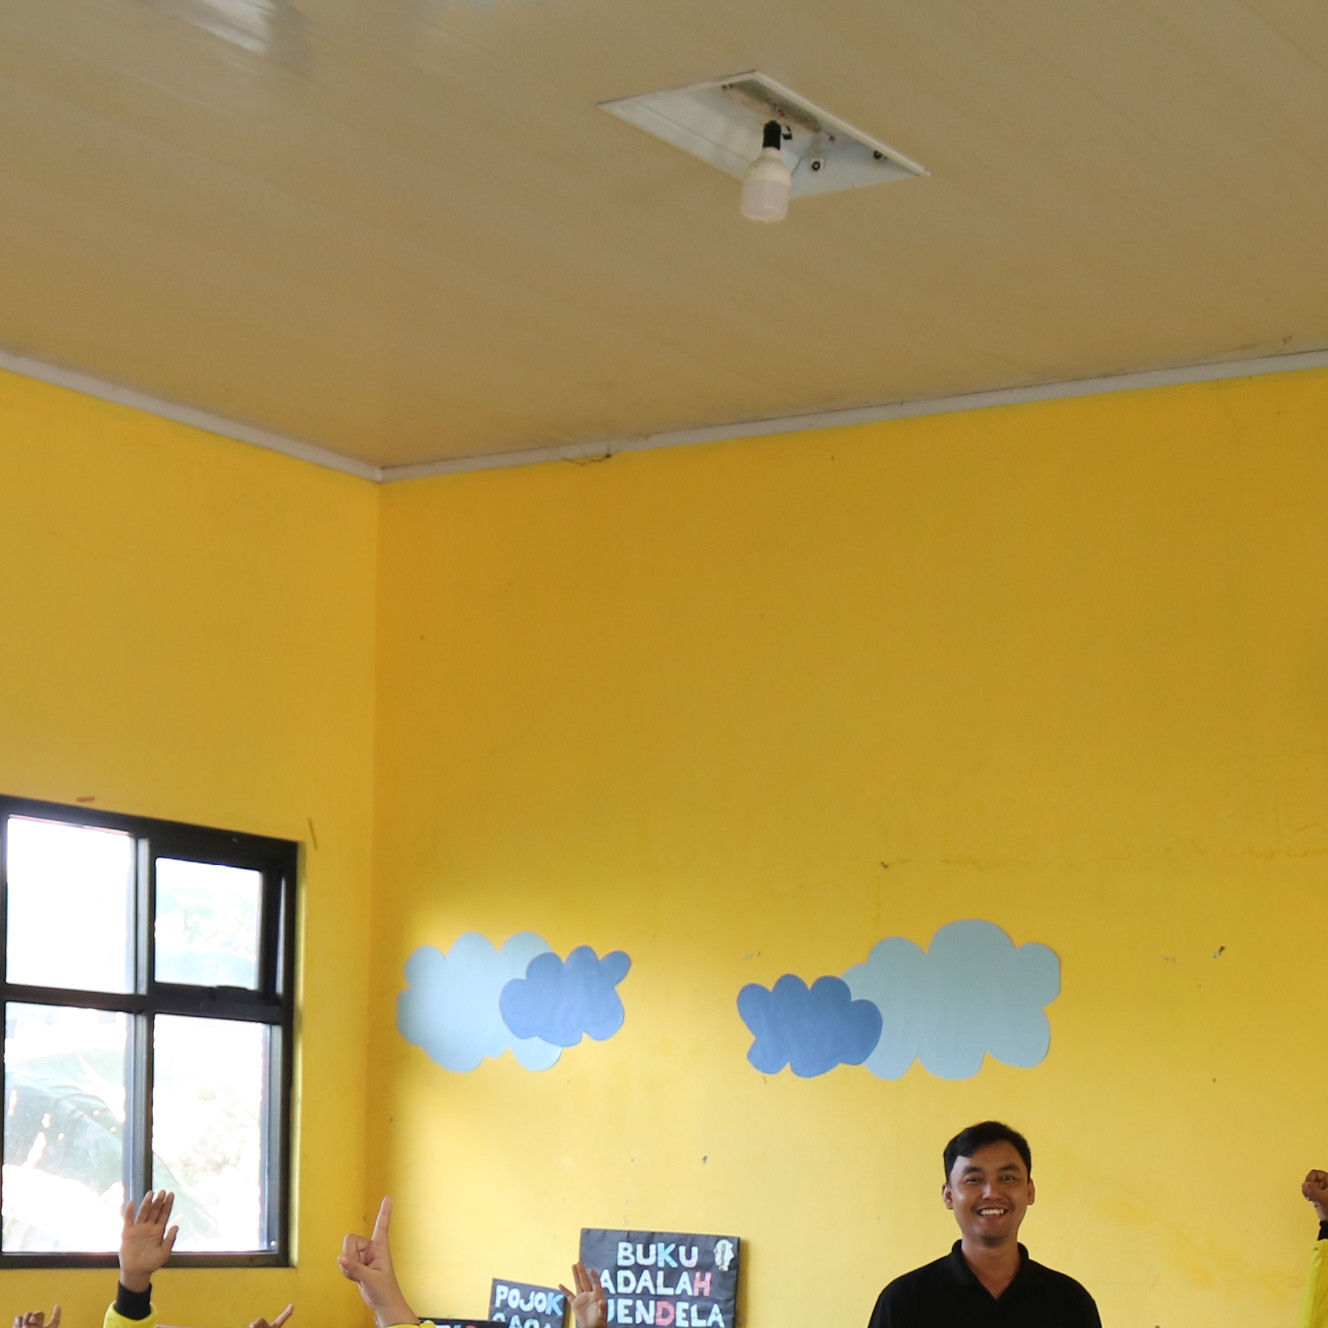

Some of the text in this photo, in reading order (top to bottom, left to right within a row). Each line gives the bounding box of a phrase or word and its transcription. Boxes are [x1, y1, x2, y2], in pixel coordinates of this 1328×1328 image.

[617, 1241, 699, 1268] BUKU
[599, 1269, 712, 1297] ADALAH
[495, 1285, 565, 1316] POJOK
